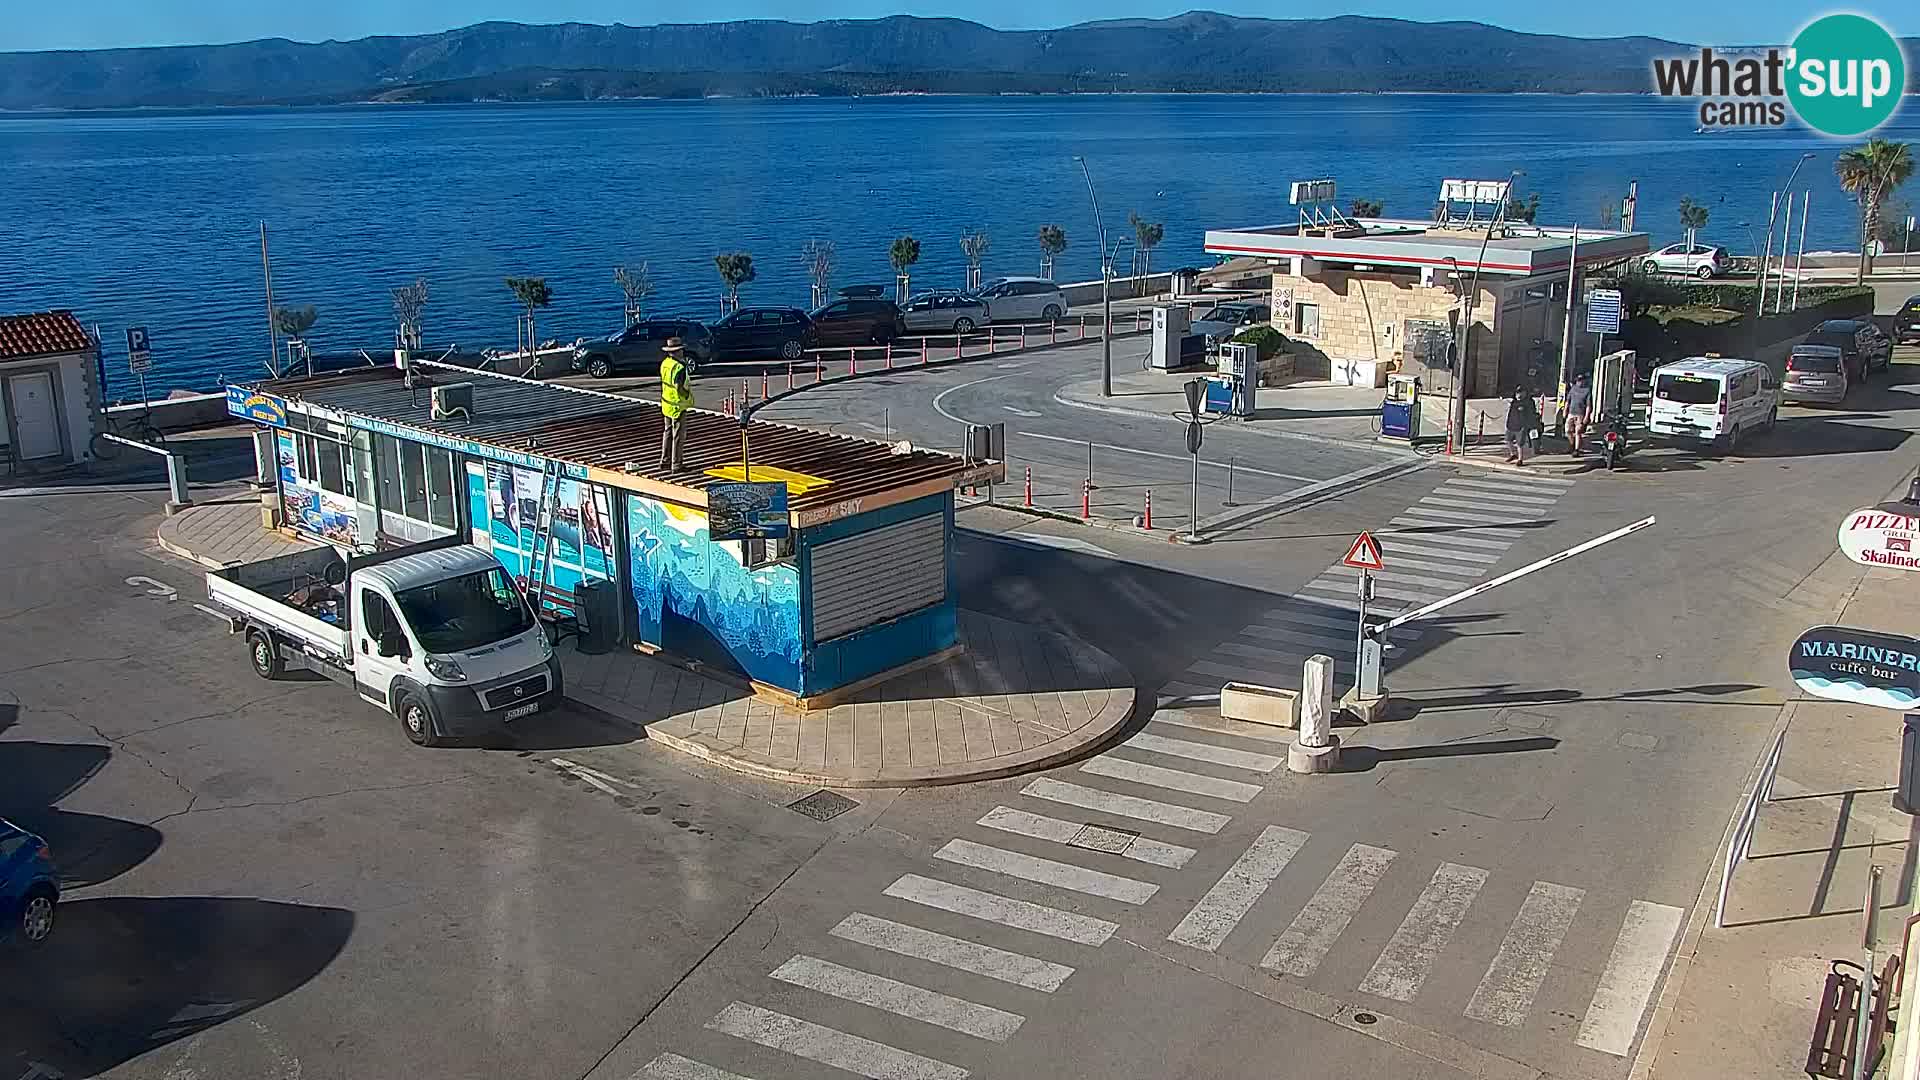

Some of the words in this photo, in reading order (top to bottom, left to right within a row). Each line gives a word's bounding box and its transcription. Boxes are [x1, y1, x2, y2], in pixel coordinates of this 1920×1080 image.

[132, 331, 143, 348] P
[479, 445, 493, 456] BUS
[494, 448, 527, 464] STATION
[1850, 515, 1920, 532] PIZZE
[1883, 530, 1918, 540] GRILL
[1800, 641, 1920, 672] MARINER
[1830, 661, 1867, 675] caffe
[1871, 665, 1898, 680] bar
